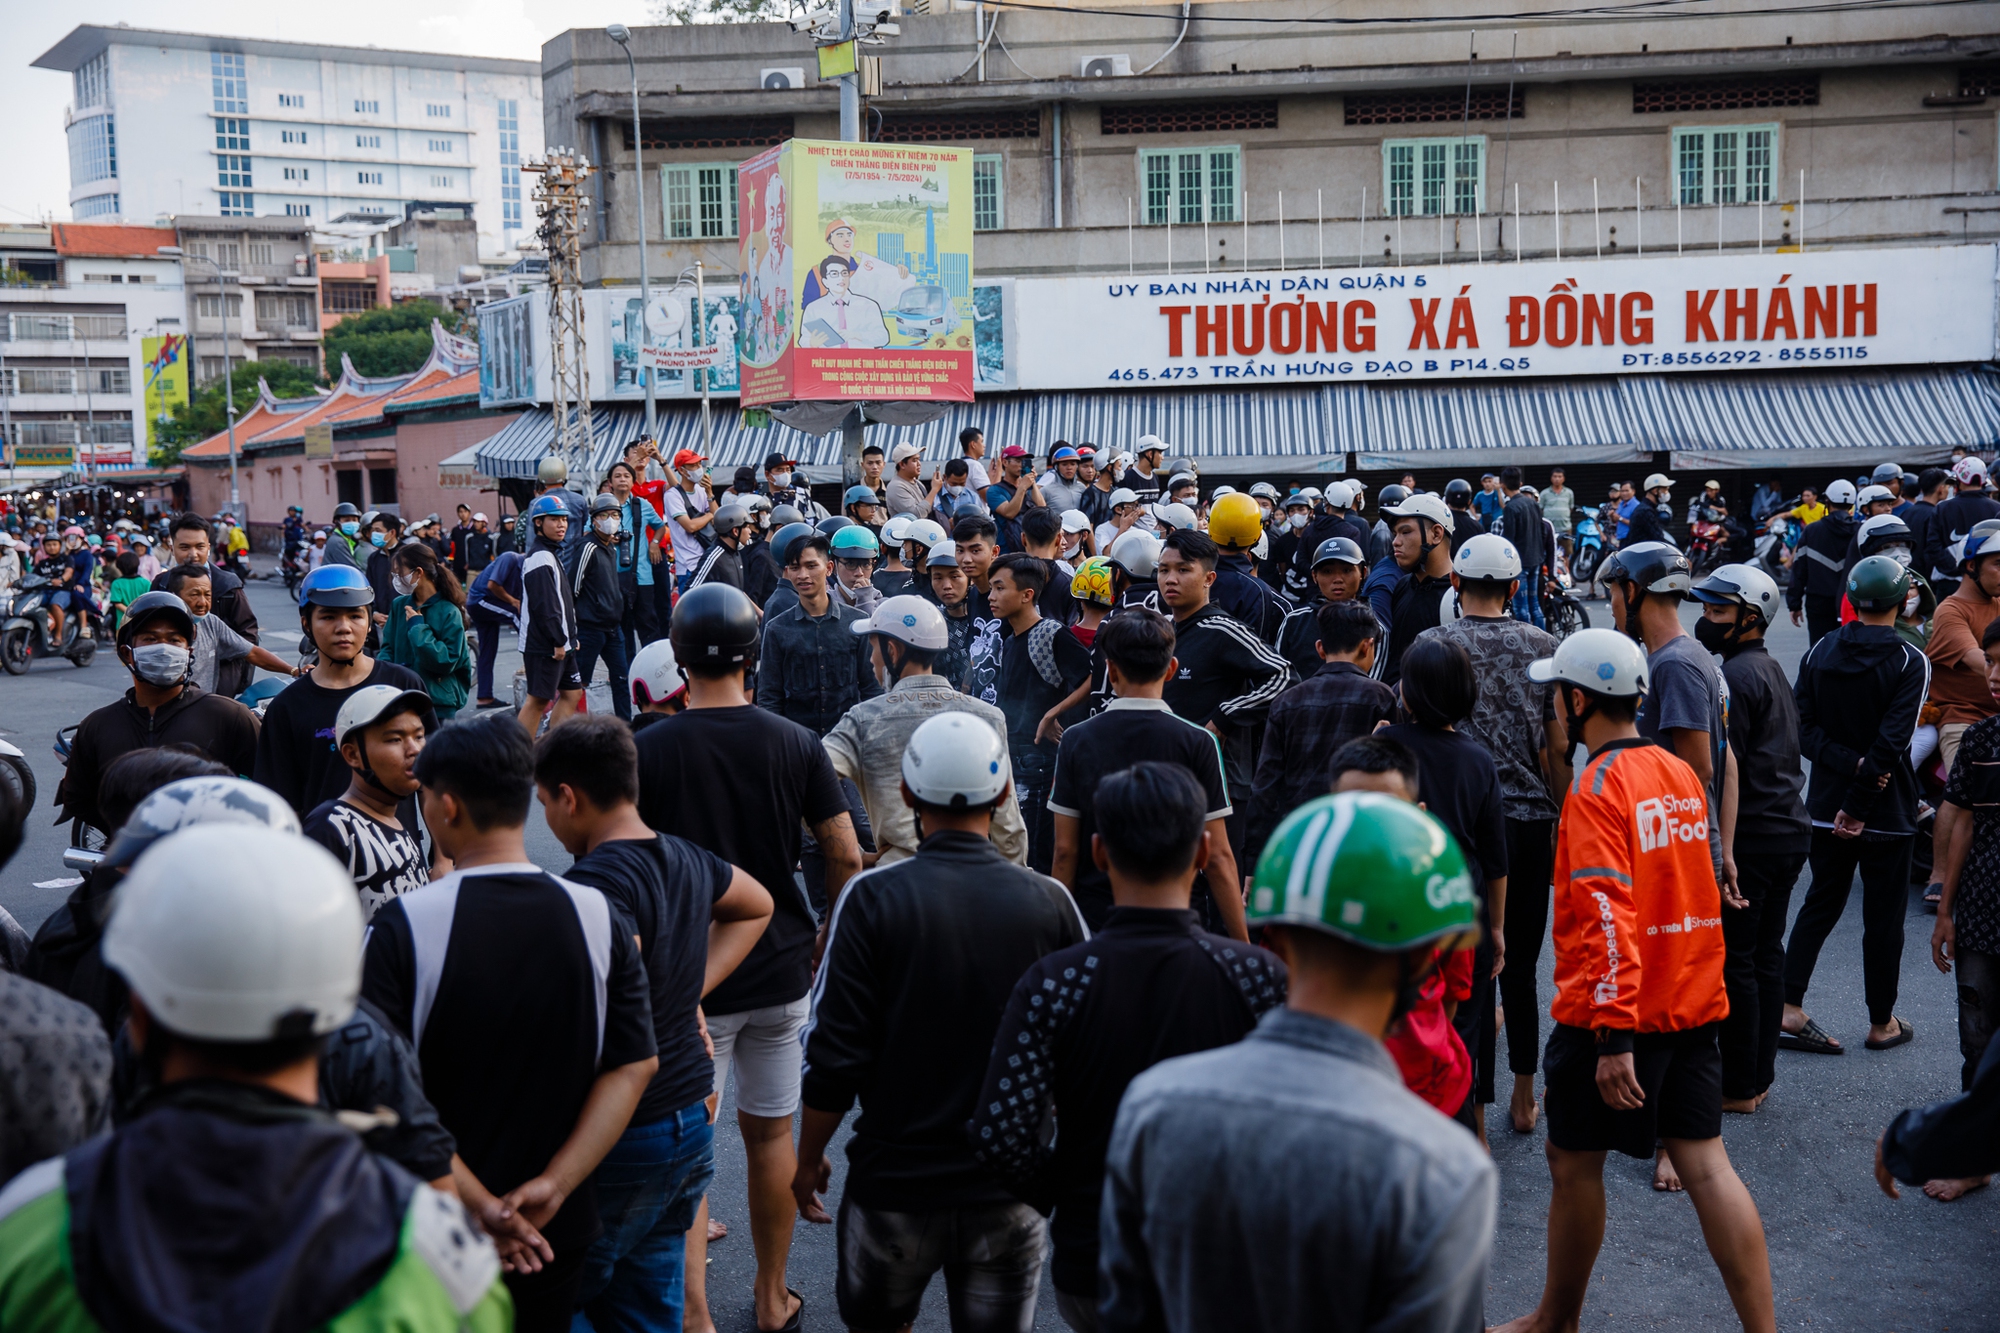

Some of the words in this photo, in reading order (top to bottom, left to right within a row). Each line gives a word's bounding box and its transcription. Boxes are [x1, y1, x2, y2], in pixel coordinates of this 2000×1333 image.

[808, 146, 830, 157] NHIỆT
[832, 147, 847, 158] LIỆT
[850, 149, 870, 157] CHÀO
[872, 149, 894, 158] MỪNG
[908, 151, 927, 161] NIỆM
[930, 153, 938, 161] 70
[831, 158, 854, 168] CHIẾN
[856, 159, 880, 169] THẮNG
[883, 161, 900, 172] ĐIỆN
[902, 162, 919, 171] BIÊN
[922, 162, 936, 172] PHỦ
[845, 172, 880, 180] (7/5/1954
[888, 174, 922, 183] 7/5/2024)
[1149, 282, 1197, 296] BAN
[1206, 277, 1271, 294] NHÂN
[1282, 276, 1329, 292] DÂN
[1339, 273, 1405, 291] QUẬN
[1414, 275, 1427, 287] 5
[1160, 294, 1376, 357] THƯƠNG
[1408, 285, 1479, 350] XÁ
[1506, 278, 1654, 348] ĐỒNG
[1685, 274, 1878, 343] KHÁNH
[656, 359, 685, 367] PHÙNG
[1623, 351, 1761, 366] ĐT:8556292
[1779, 347, 1868, 361] 8555115
[1108, 367, 1199, 381] 465.473
[1209, 359, 1276, 378] TRẦN
[1286, 361, 1354, 377] HƯNG
[1365, 361, 1413, 377] ĐẠO
[1424, 360, 1439, 372] B
[1451, 358, 1530, 372] P14.Q5
[886, 691, 972, 704] GIVENCHY
